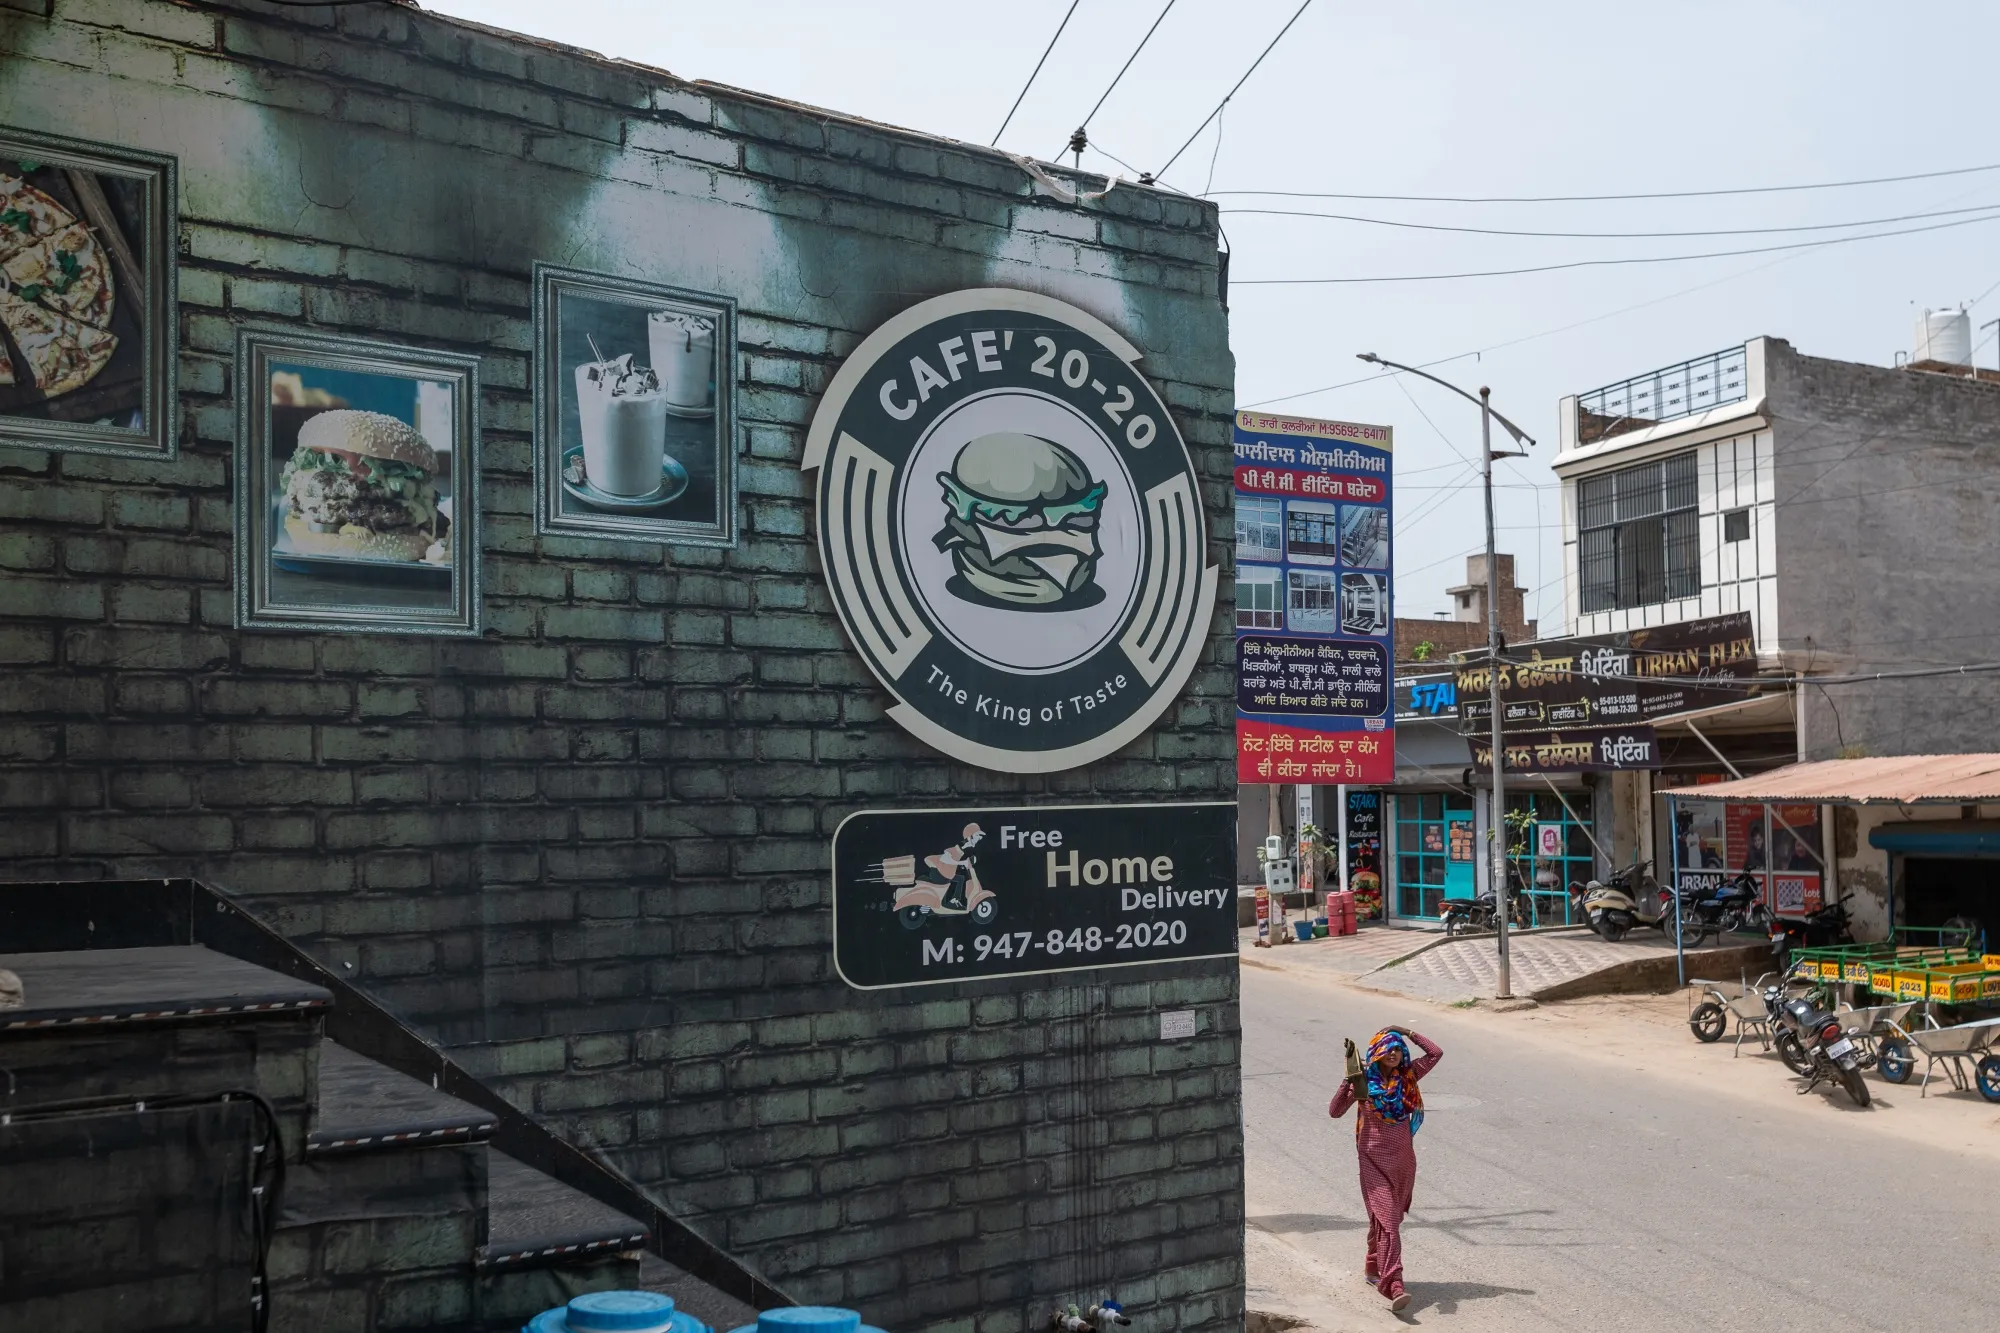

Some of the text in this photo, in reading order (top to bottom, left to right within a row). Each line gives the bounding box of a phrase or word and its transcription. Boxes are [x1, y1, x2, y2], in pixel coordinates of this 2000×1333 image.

[879, 331, 1158, 449] CAFE' 20-20
[1636, 637, 1753, 677] URBAN FLEX
[1270, 676, 1286, 689] ਅਤੇ
[925, 665, 1129, 725] The King of Taste
[1254, 692, 1276, 705] ਆਦਿ
[1280, 693, 1308, 706] ਤਿਆਰ
[1310, 694, 1328, 707] ਕੀਤੇ
[1299, 735, 1335, 753] ਸਟੀਲ
[1339, 740, 1354, 754] ਦਾ
[1357, 736, 1379, 754] ਕੰਮ
[1535, 733, 1594, 767] ਫਲੈਕਸ
[1258, 757, 1273, 777] ਵੀ
[1277, 758, 1307, 777] ਕੀਤਾ
[1312, 760, 1340, 777] ਜਾਂਦਾ
[1349, 793, 1377, 811] STARK
[1354, 813, 1375, 823] Cafe
[1000, 825, 1063, 849] Free
[1047, 848, 1174, 889] Home
[1121, 884, 1230, 914] Delivery
[922, 920, 1187, 966] M: 947-848-2020
[1873, 977, 1949, 996] GOOD 2023 LUCK
